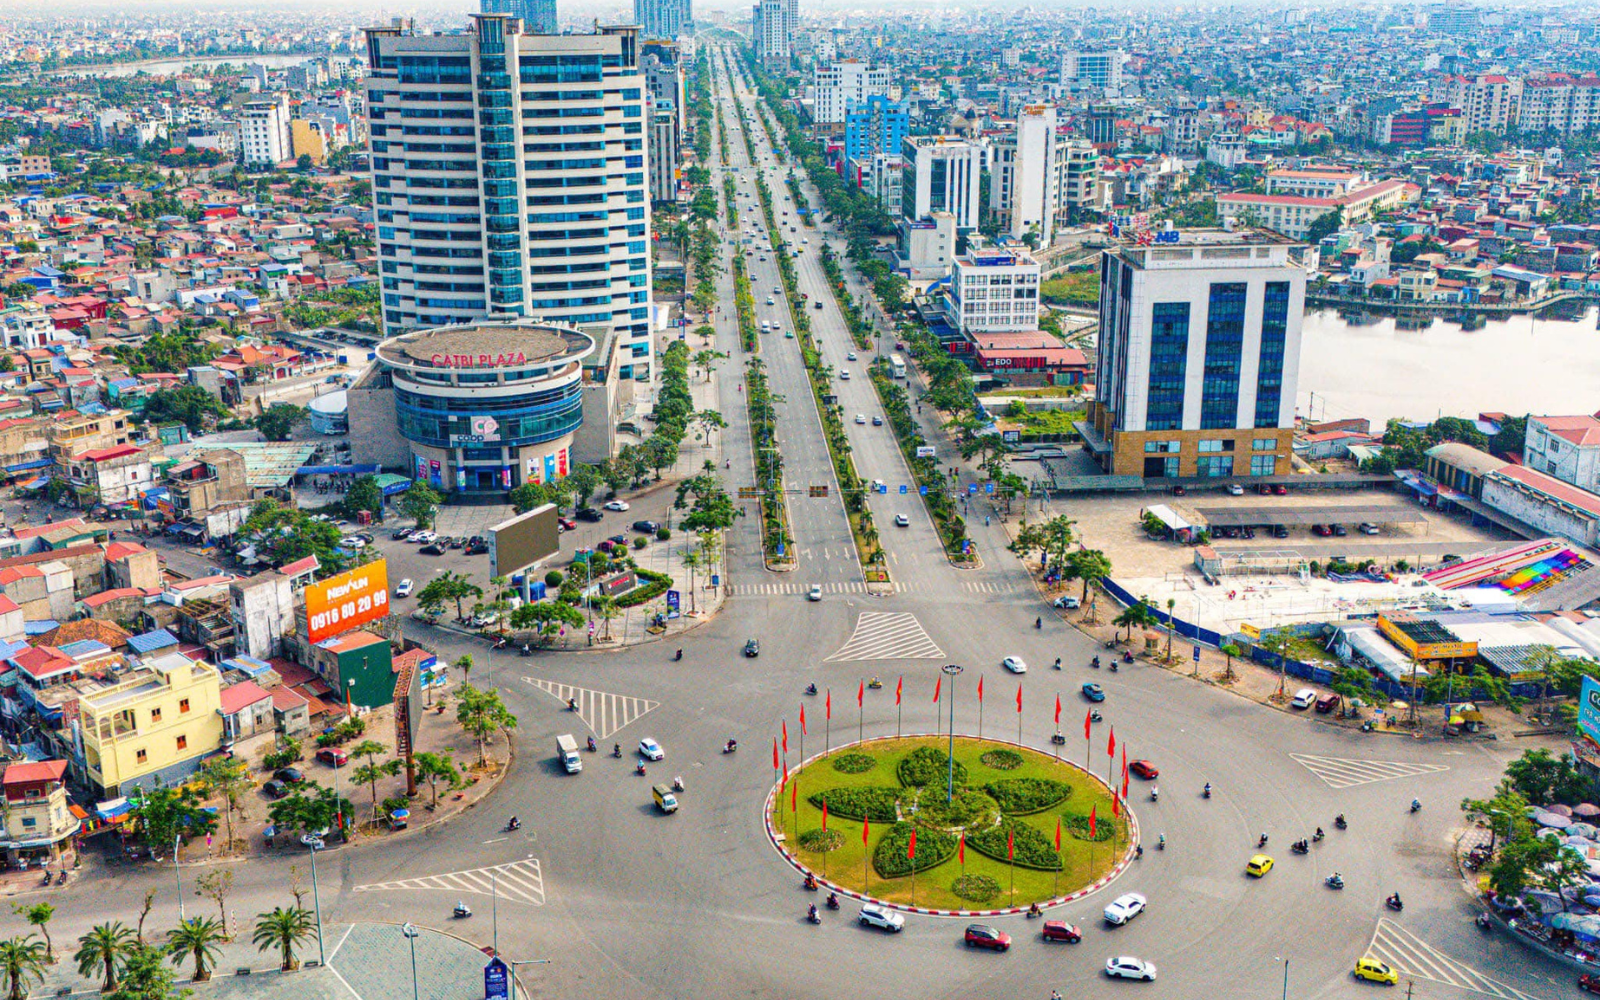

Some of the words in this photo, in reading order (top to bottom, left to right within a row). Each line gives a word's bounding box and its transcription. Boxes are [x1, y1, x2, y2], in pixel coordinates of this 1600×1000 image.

[917, 138, 937, 147] BIDV
[1155, 231, 1180, 242] MB
[479, 352, 526, 366] PLAZA
[311, 608, 339, 631] 0916
[341, 602, 355, 619] 80
[358, 595, 371, 613] 20
[373, 589, 386, 607] 99
